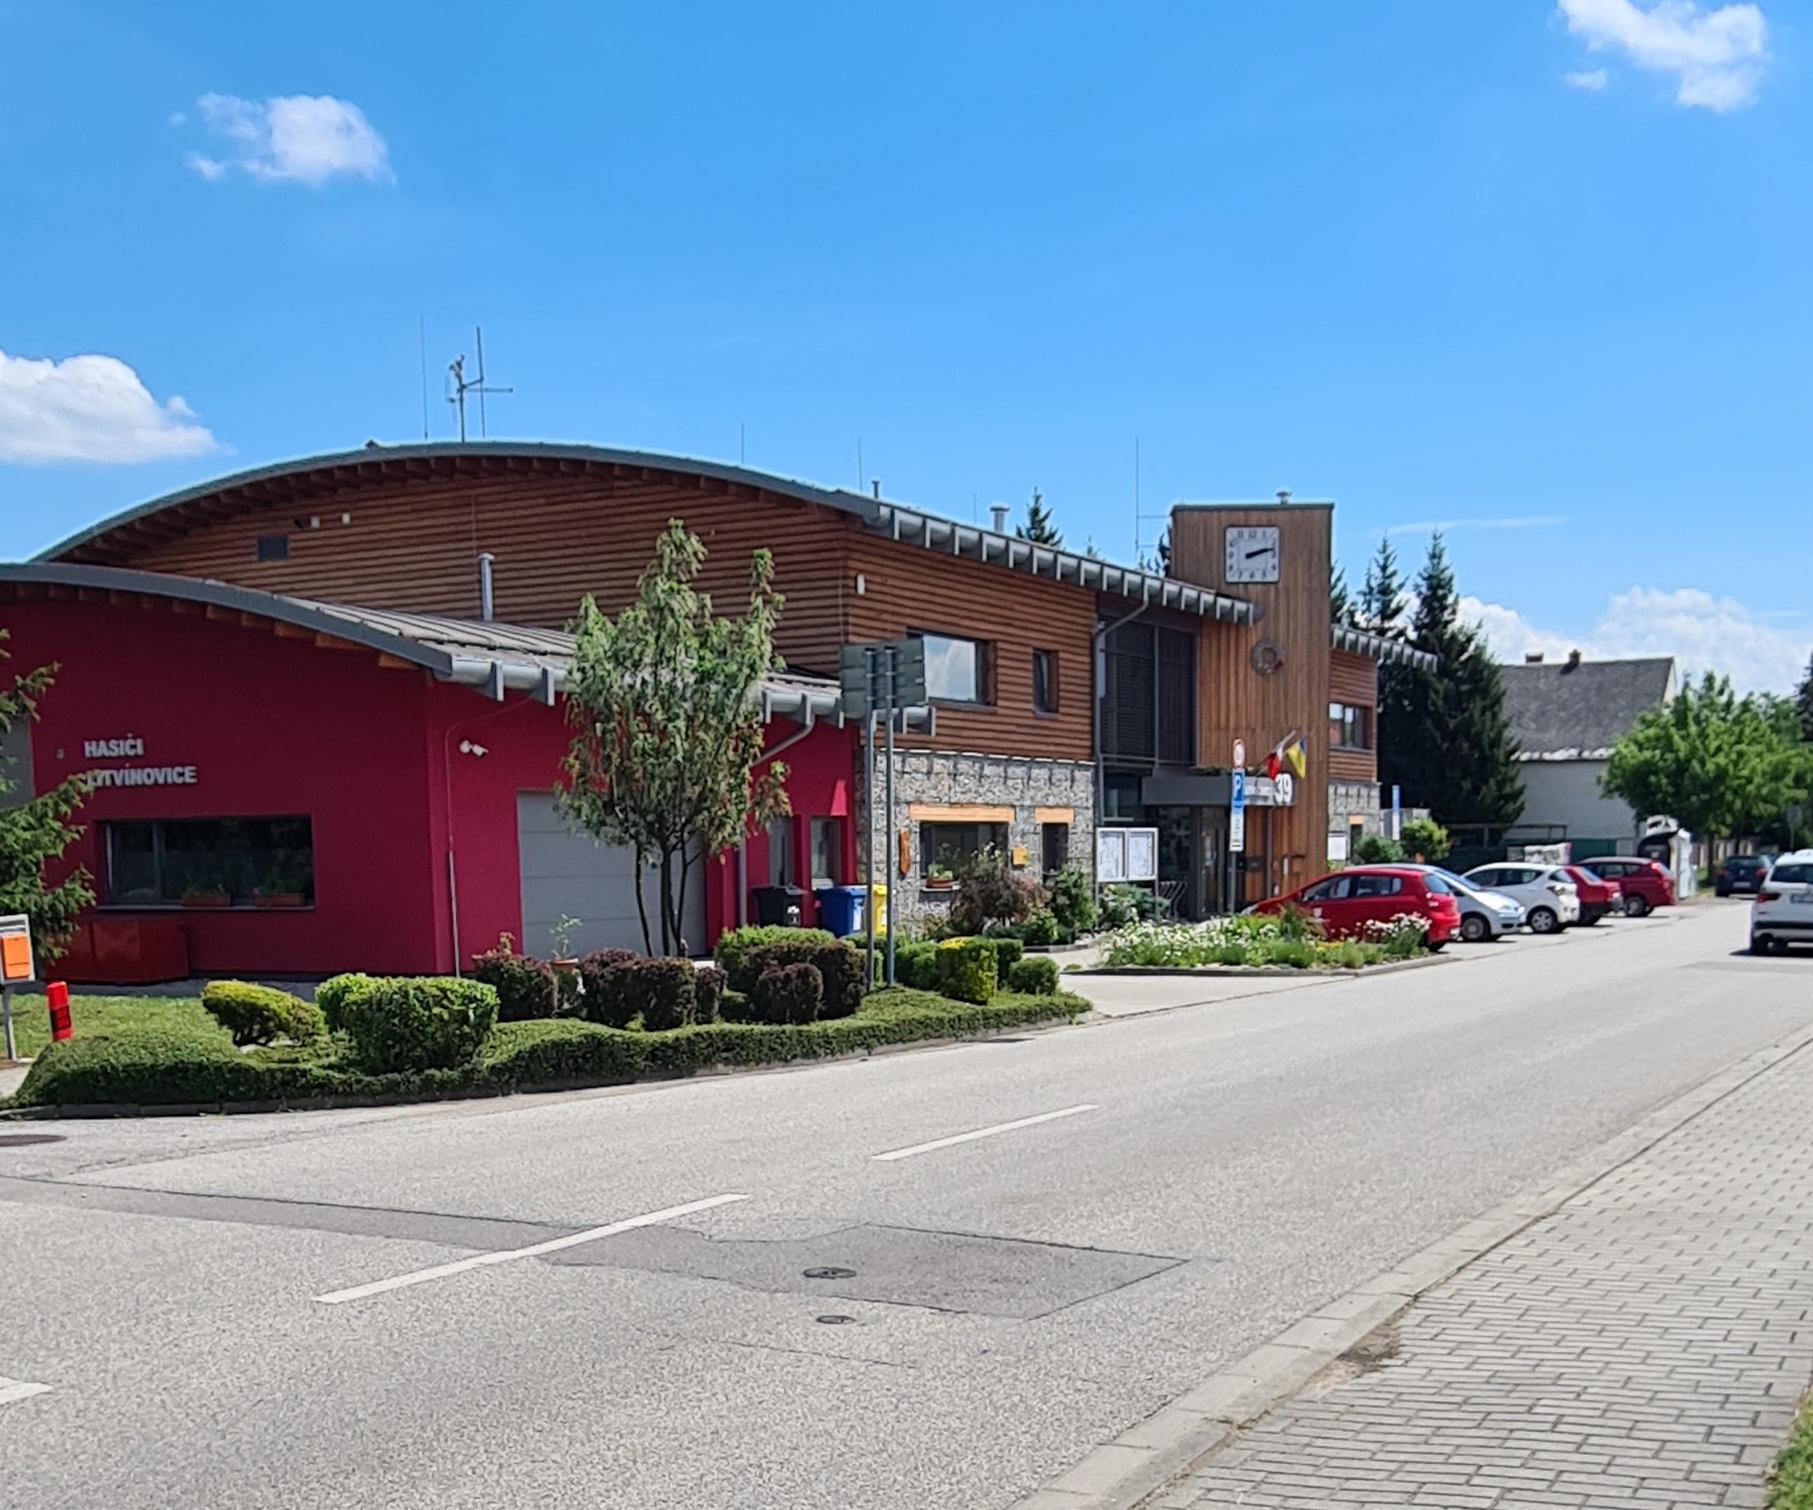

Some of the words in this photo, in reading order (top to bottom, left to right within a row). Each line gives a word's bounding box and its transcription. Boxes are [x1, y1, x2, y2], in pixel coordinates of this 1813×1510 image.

[84, 733, 144, 758] HASIČI
[1233, 775, 1242, 801] P
[1275, 773, 1293, 803] 39
